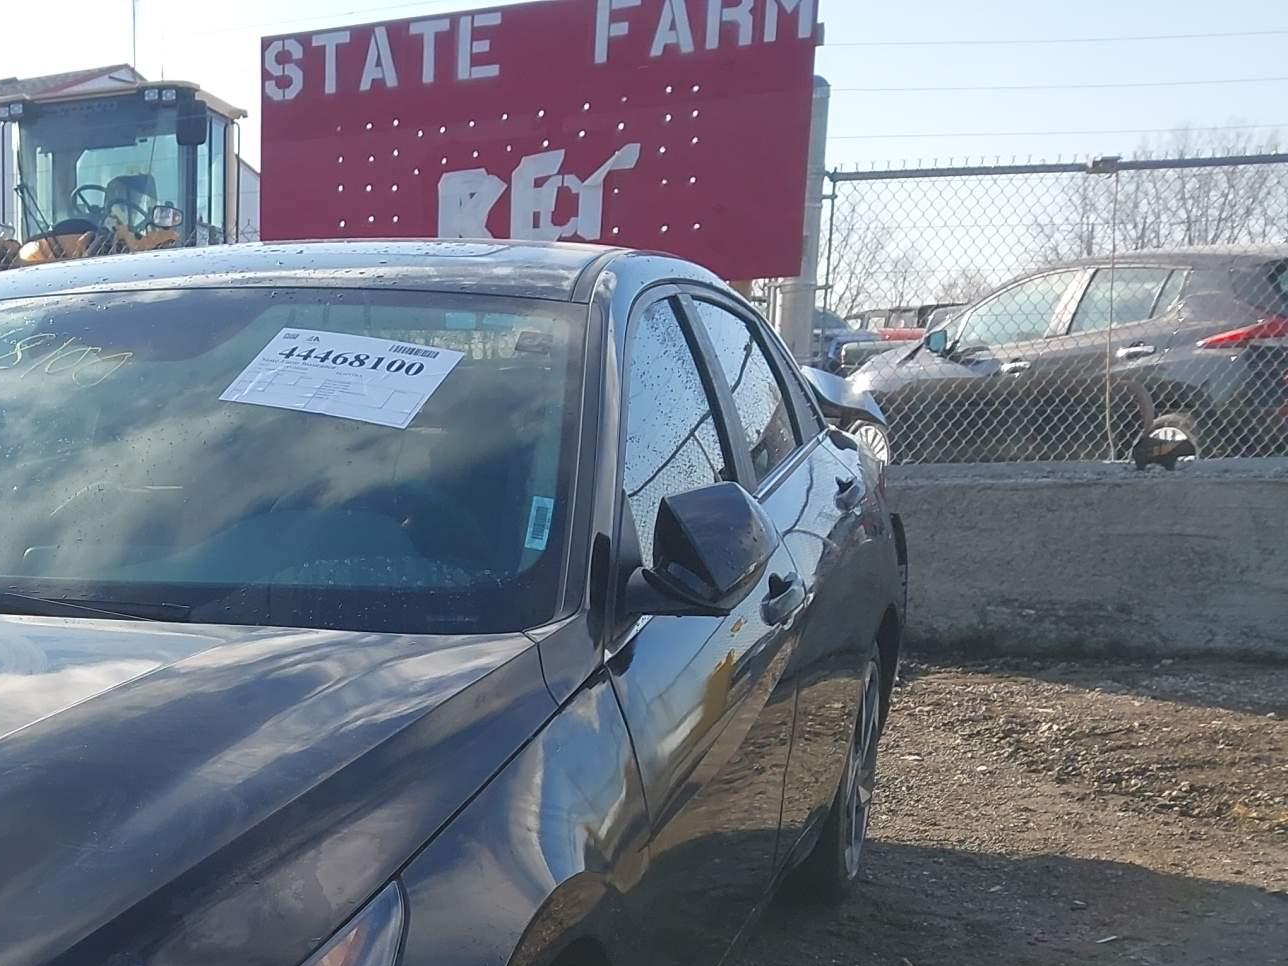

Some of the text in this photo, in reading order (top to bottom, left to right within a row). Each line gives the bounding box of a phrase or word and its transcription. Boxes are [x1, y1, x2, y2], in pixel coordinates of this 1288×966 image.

[264, 0, 812, 100] STATE FARM
[278, 345, 425, 377] 44468100
